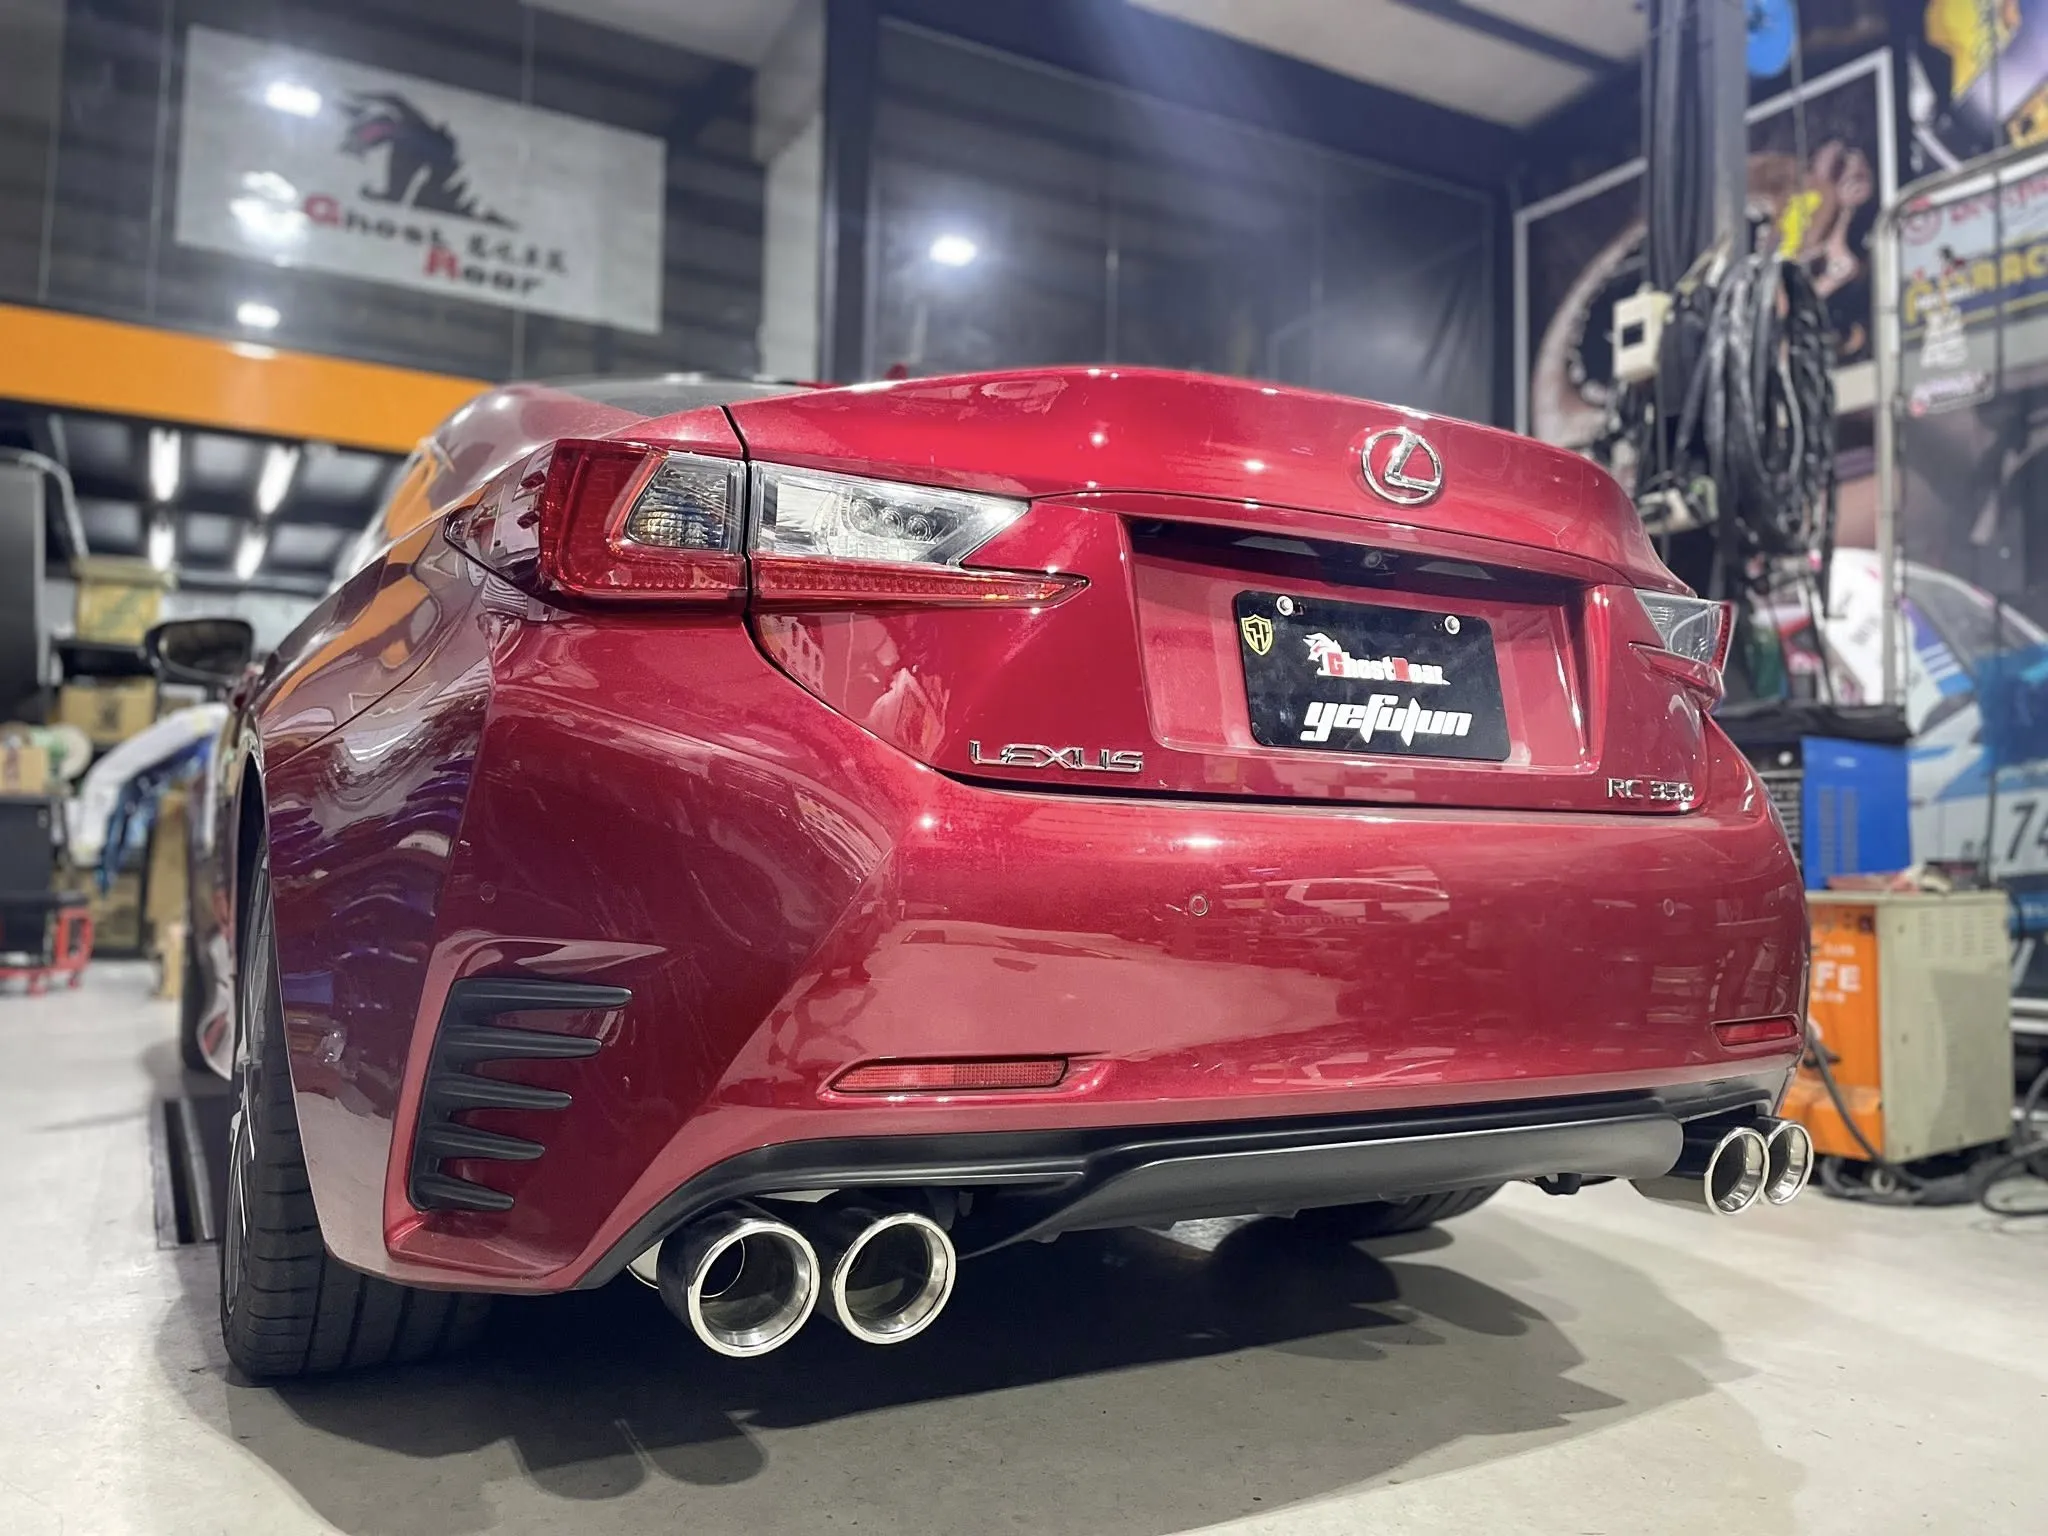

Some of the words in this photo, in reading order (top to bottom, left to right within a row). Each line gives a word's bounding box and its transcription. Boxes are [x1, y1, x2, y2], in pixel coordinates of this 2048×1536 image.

[969, 740, 1143, 772] LEXUS
[1607, 778, 1644, 798] RC
[1650, 780, 1695, 801] 350
